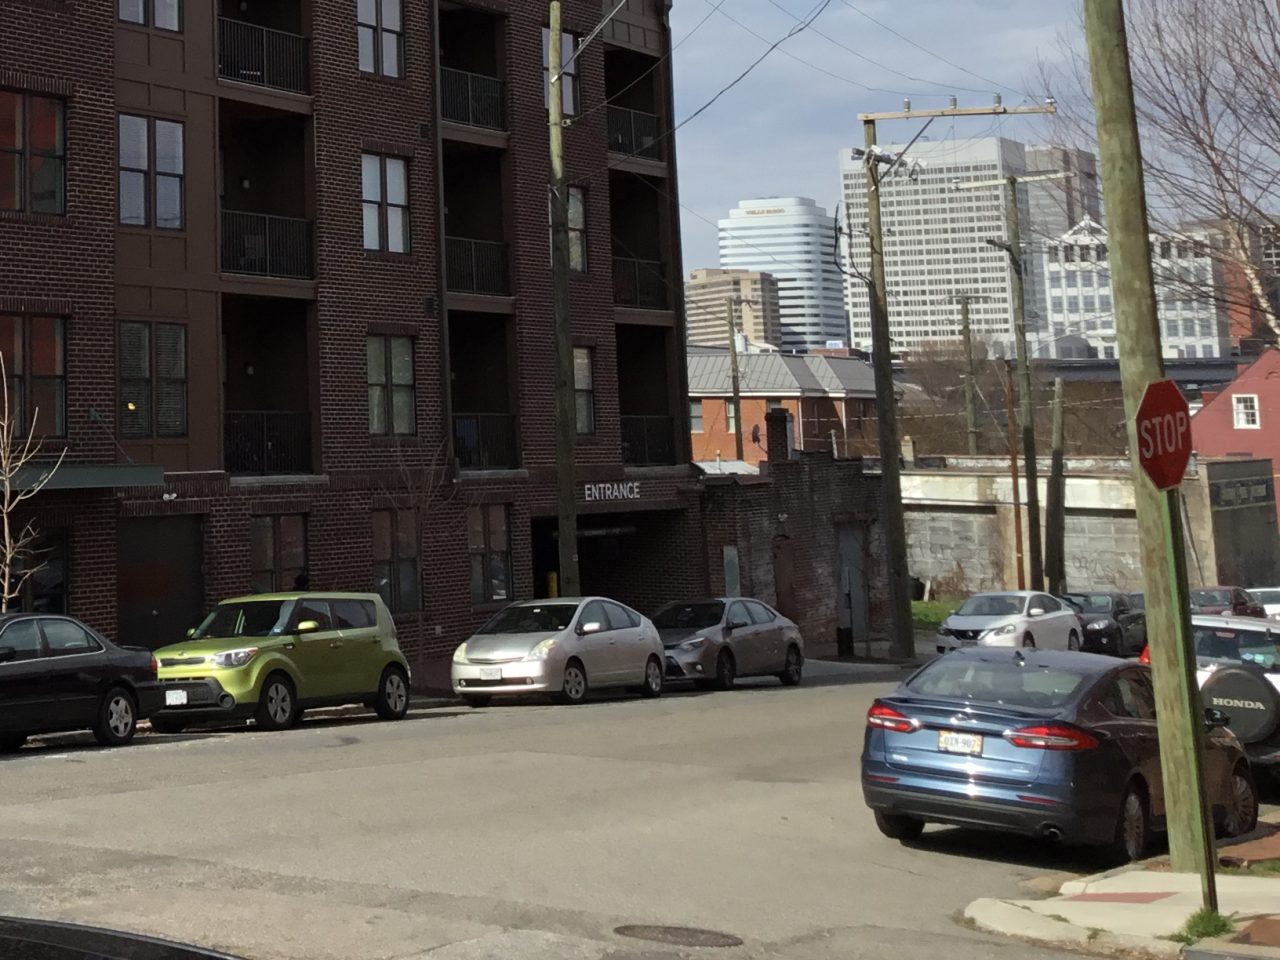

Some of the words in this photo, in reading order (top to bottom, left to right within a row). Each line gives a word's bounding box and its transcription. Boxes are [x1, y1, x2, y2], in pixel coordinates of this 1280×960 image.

[1140, 411, 1188, 458] STOP
[584, 482, 641, 501] ENTRANCE
[1212, 697, 1266, 710] HONDA
